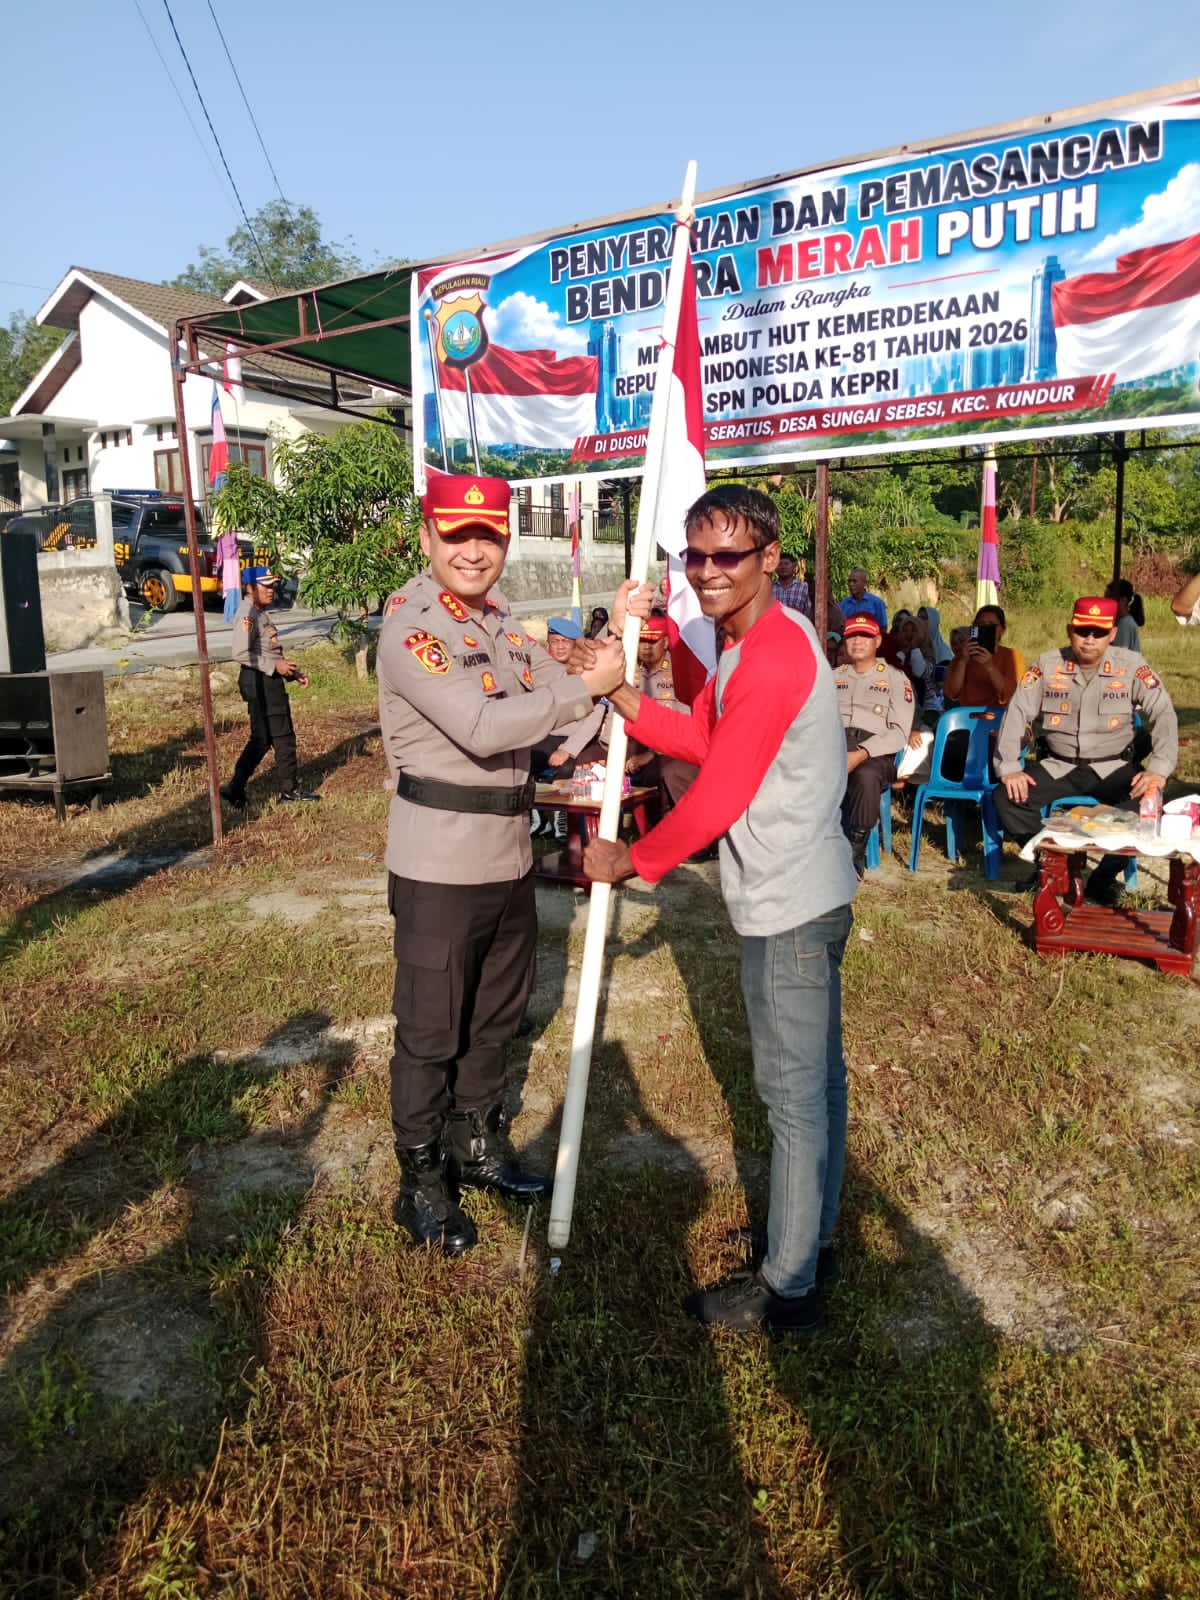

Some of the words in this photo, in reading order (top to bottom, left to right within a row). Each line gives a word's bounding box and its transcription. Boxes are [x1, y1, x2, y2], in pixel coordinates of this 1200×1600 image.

[772, 189, 846, 236] DAN
[860, 121, 1161, 218] PEMASANGAN
[567, 255, 740, 323] BENDRA
[757, 219, 921, 288] MERAH
[938, 184, 1097, 255] PUTIH
[434, 278, 471, 296] KEPULAUAN
[471, 277, 486, 287] RIAU
[722, 299, 785, 321] Dalam
[791, 282, 871, 309] Rangka
[768, 322, 810, 347] HUT
[817, 291, 1000, 339] KEMERDEKAAN
[704, 351, 809, 385] INDONESIA
[815, 340, 876, 369] KE-81
[884, 328, 961, 359] TAHUN
[968, 318, 1028, 347] 2026
[706, 388, 745, 413] SPN
[753, 379, 823, 408] POLDA
[831, 368, 898, 398] KEPRI
[709, 420, 774, 441] SERATUS,
[779, 417, 817, 433] DESA
[821, 408, 881, 429] SUNGAI
[885, 400, 945, 421] SEBESI,
[951, 396, 989, 414] KEC.
[996, 385, 1075, 409] KUNDUR
[594, 440, 606, 453] DI
[610, 434, 649, 451] DUSUN
[1103, 691, 1129, 699] POLRI
